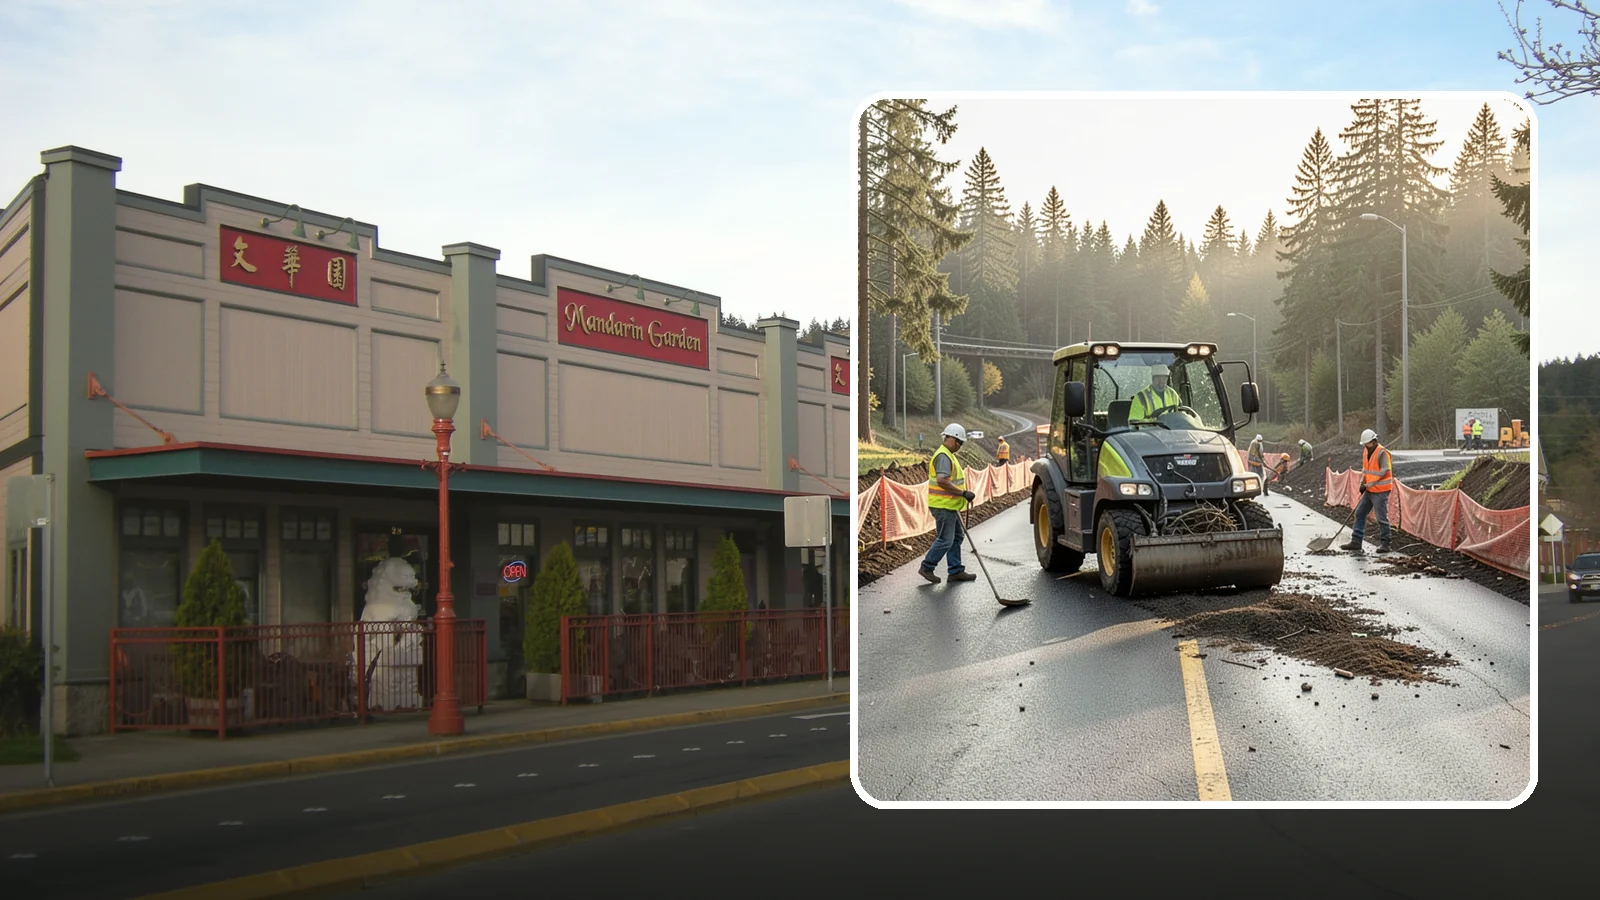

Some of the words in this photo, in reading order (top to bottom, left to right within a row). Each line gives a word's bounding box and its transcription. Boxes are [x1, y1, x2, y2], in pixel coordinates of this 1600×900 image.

[230, 235, 347, 291] 文華園
[564, 302, 644, 341] Mandarin
[648, 320, 701, 352] Garden
[503, 565, 526, 578] OPEN
